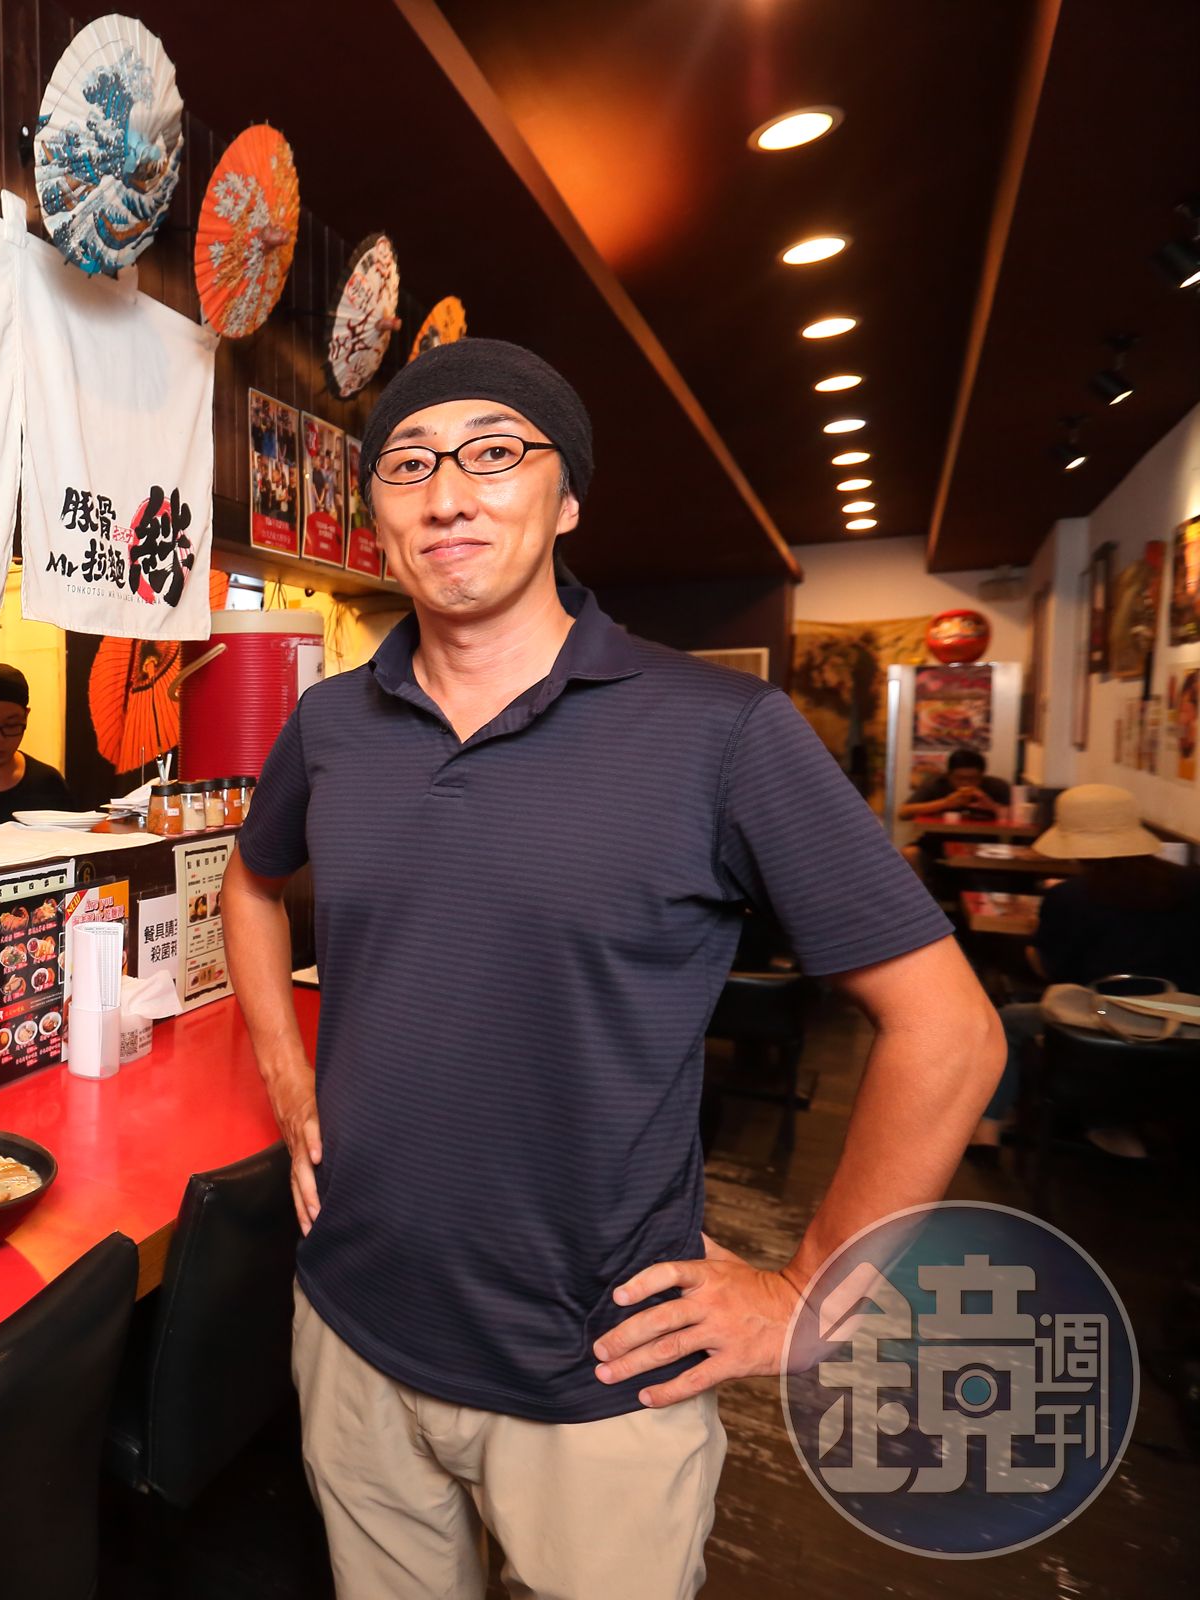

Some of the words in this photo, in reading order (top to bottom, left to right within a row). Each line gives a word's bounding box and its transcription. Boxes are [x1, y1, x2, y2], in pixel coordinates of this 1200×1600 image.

[60, 486, 117, 541] 豚骨
[144, 918, 178, 944] 餐具請
